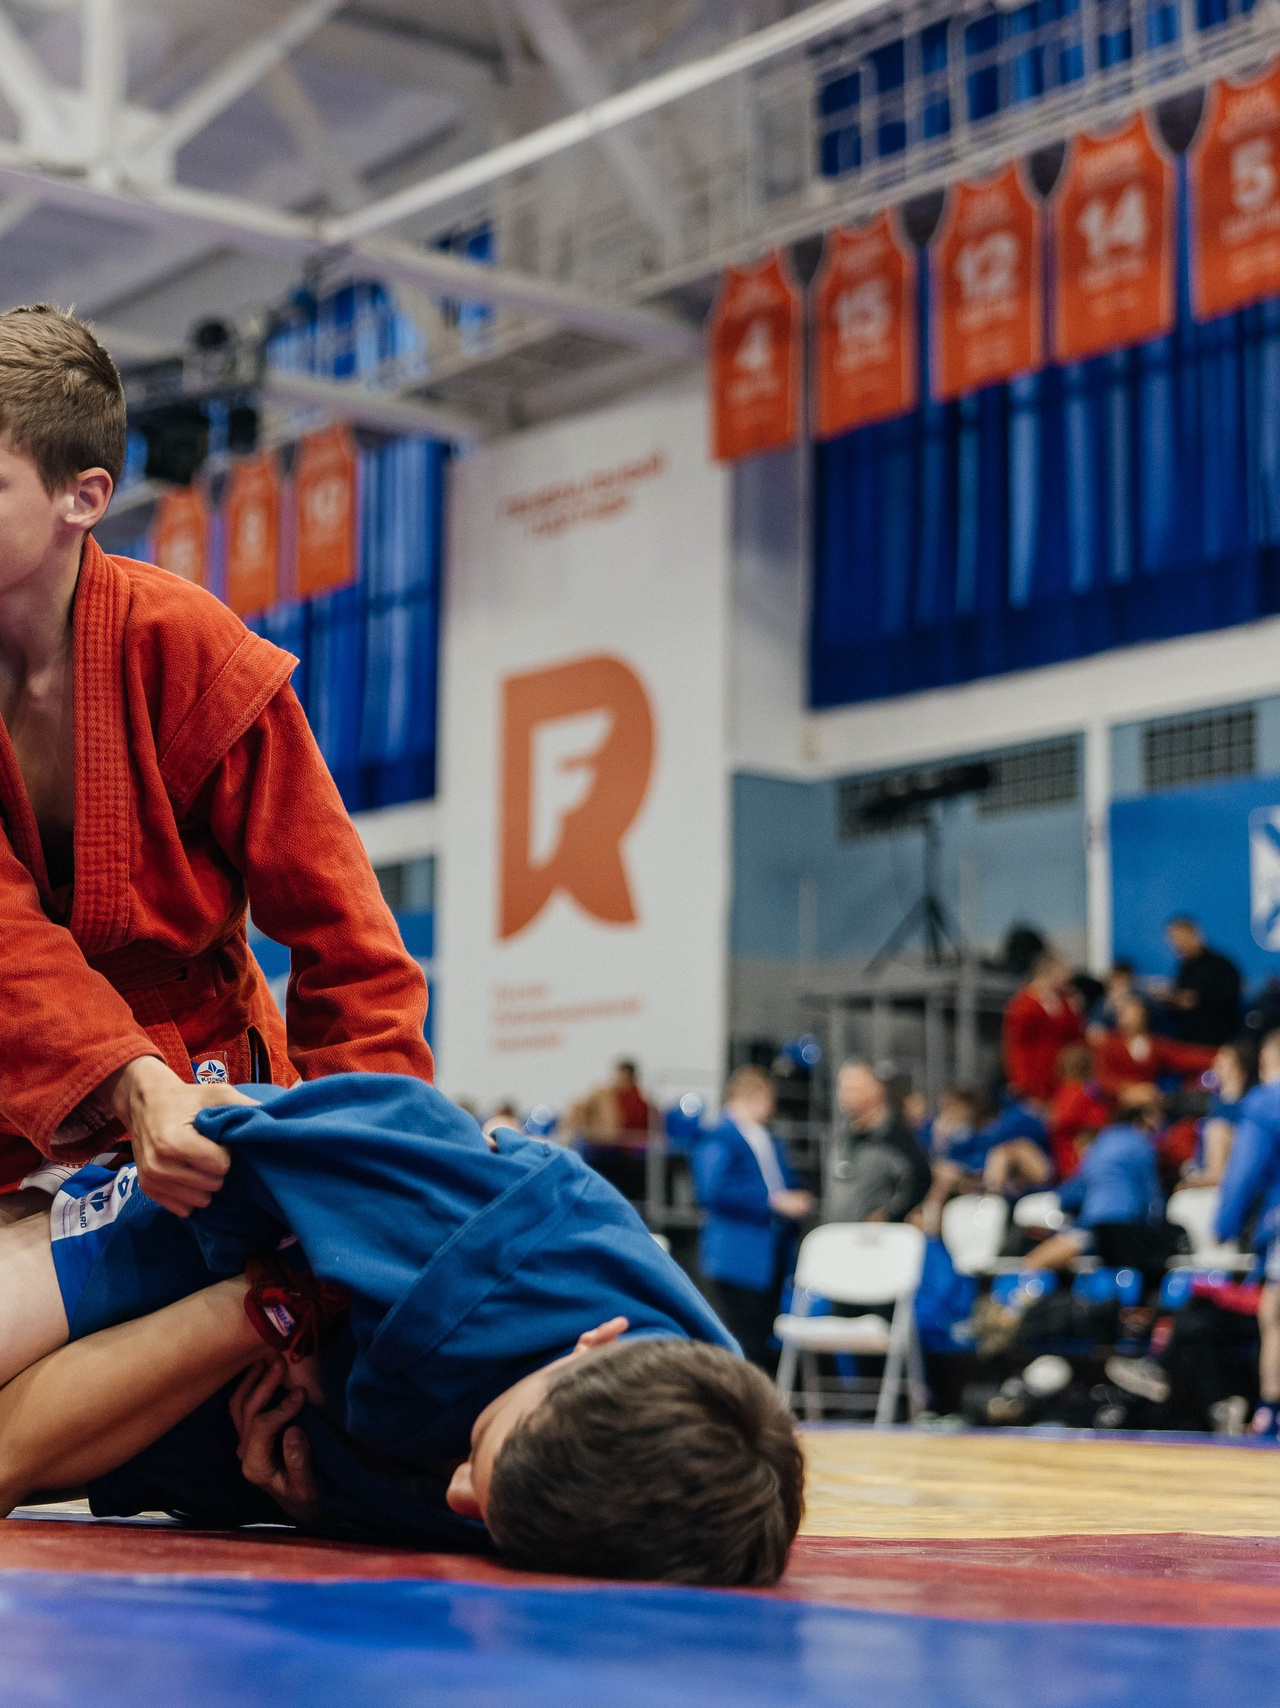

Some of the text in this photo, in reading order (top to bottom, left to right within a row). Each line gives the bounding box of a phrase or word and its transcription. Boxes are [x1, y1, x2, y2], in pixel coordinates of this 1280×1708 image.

[1232, 137, 1276, 210] 5
[1077, 185, 1150, 258] 14
[955, 230, 1018, 300] 12
[733, 317, 773, 372] 4
